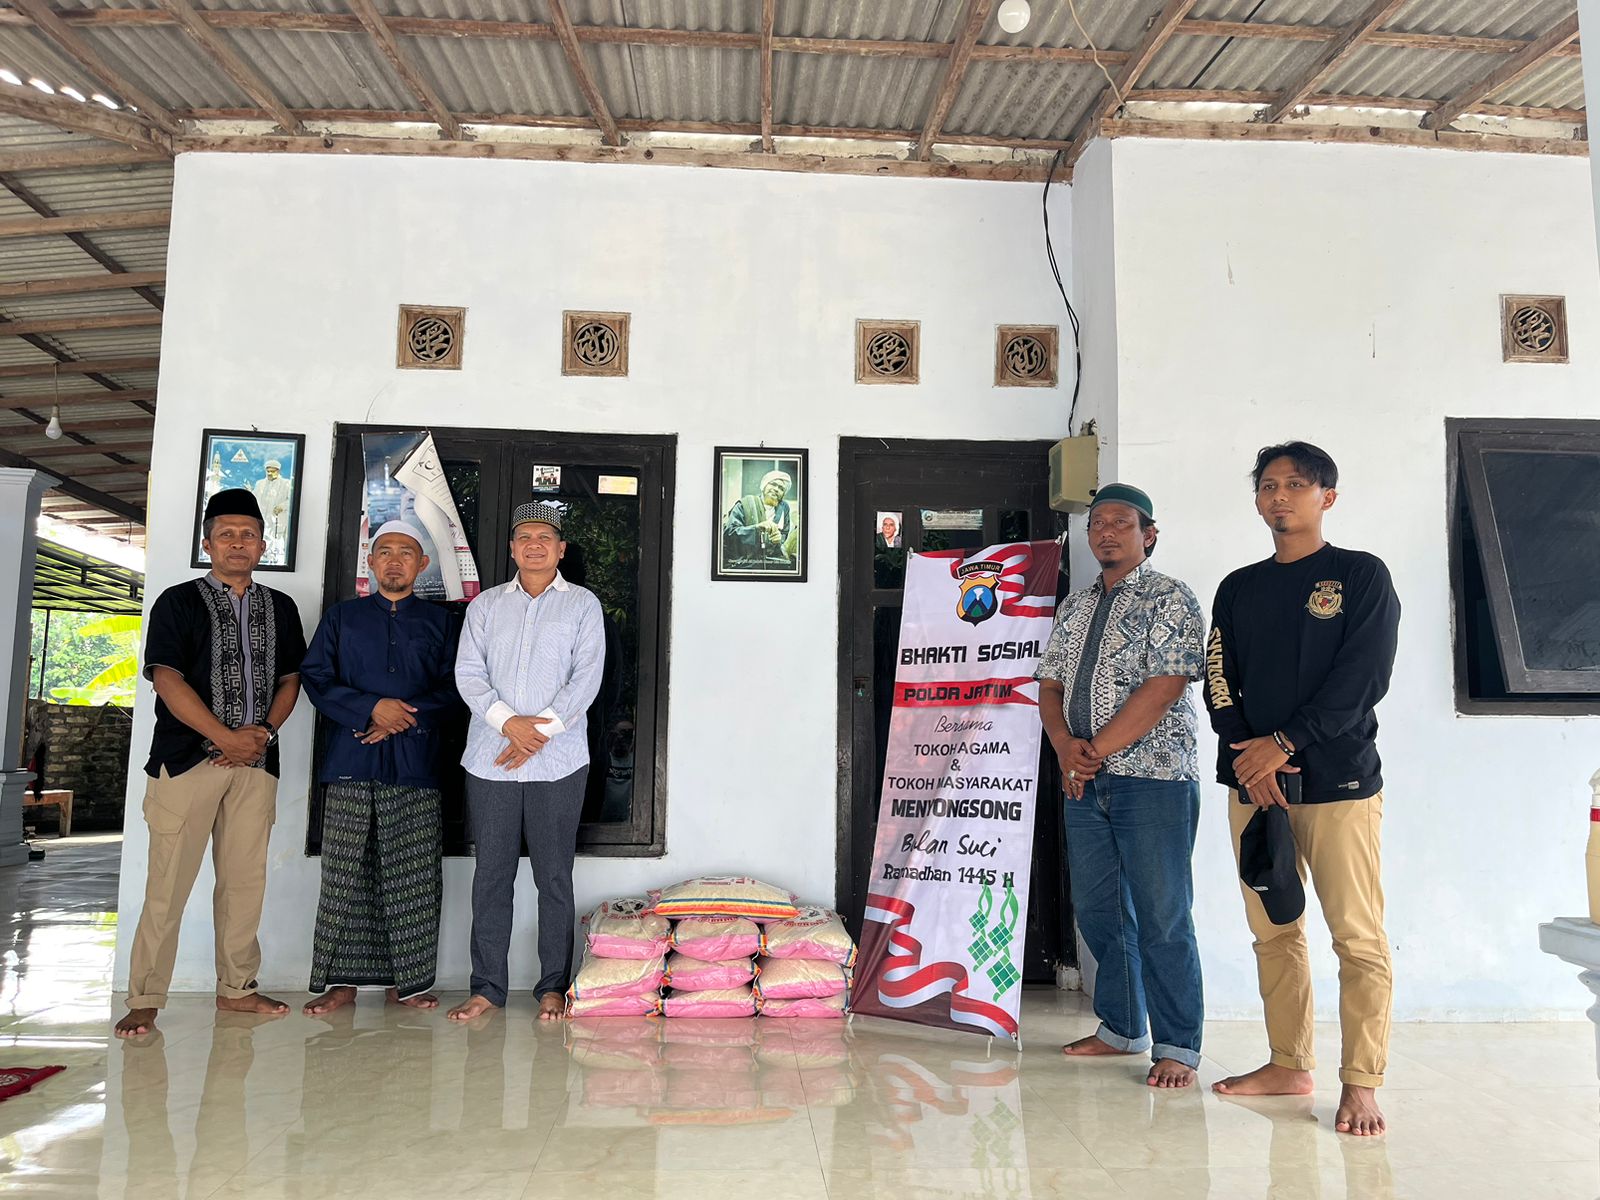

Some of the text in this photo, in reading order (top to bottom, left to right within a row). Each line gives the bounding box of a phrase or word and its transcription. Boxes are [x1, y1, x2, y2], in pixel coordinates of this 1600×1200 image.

[961, 563, 1000, 575] JAWA TIMUR
[900, 640, 1042, 665] BHAKTI SOSIAL
[904, 684, 1013, 701] POLDA JATIM
[934, 715, 993, 733] Bersama
[914, 742, 1010, 756] TOKOH AGAMA
[950, 758, 961, 771] &
[888, 776, 935, 790] TOKOH
[891, 798, 1022, 821] MENYONGSONG
[956, 834, 1001, 857] Suci
[883, 863, 1015, 888] Ramadhan 1445 H
